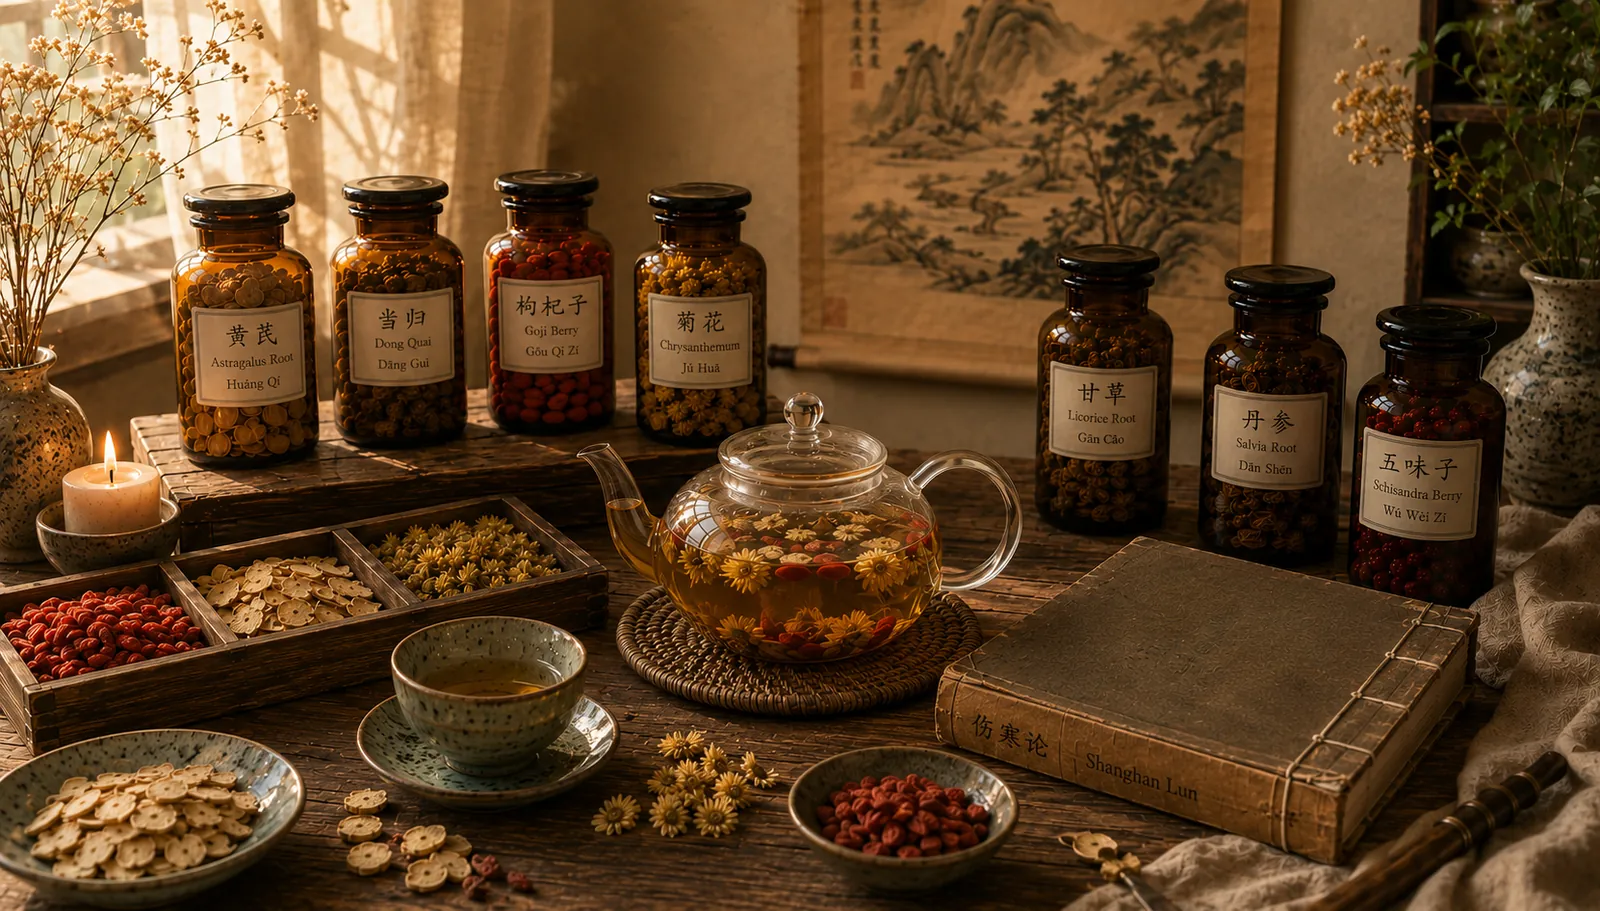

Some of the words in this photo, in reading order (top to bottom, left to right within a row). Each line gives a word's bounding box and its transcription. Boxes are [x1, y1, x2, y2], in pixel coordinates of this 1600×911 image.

[515, 294, 588, 317] 枸杞子
[378, 308, 426, 330] 当归
[676, 310, 725, 333] 菊花
[226, 322, 278, 348] 黄芪
[524, 325, 548, 338] Goji
[551, 325, 579, 338] Berry
[374, 337, 405, 352] Dong
[407, 336, 432, 350] Quai
[659, 339, 741, 355] Chrysanthemum
[211, 355, 267, 371] Astragalus
[270, 352, 294, 365] Root
[1077, 382, 1127, 406] 甘草
[1067, 409, 1109, 424] Licorice
[1111, 413, 1136, 424] Root
[1241, 409, 1295, 435] 丹参
[1236, 437, 1267, 453] Salvia
[1270, 441, 1297, 454] Root
[1379, 453, 1458, 481] 五味子
[1373, 479, 1429, 500] Schisandra
[1432, 490, 1463, 504] Berry
[971, 713, 1049, 758] 伤寒论
[1086, 752, 1160, 791] Shanghan
[1165, 776, 1199, 801] Lun
